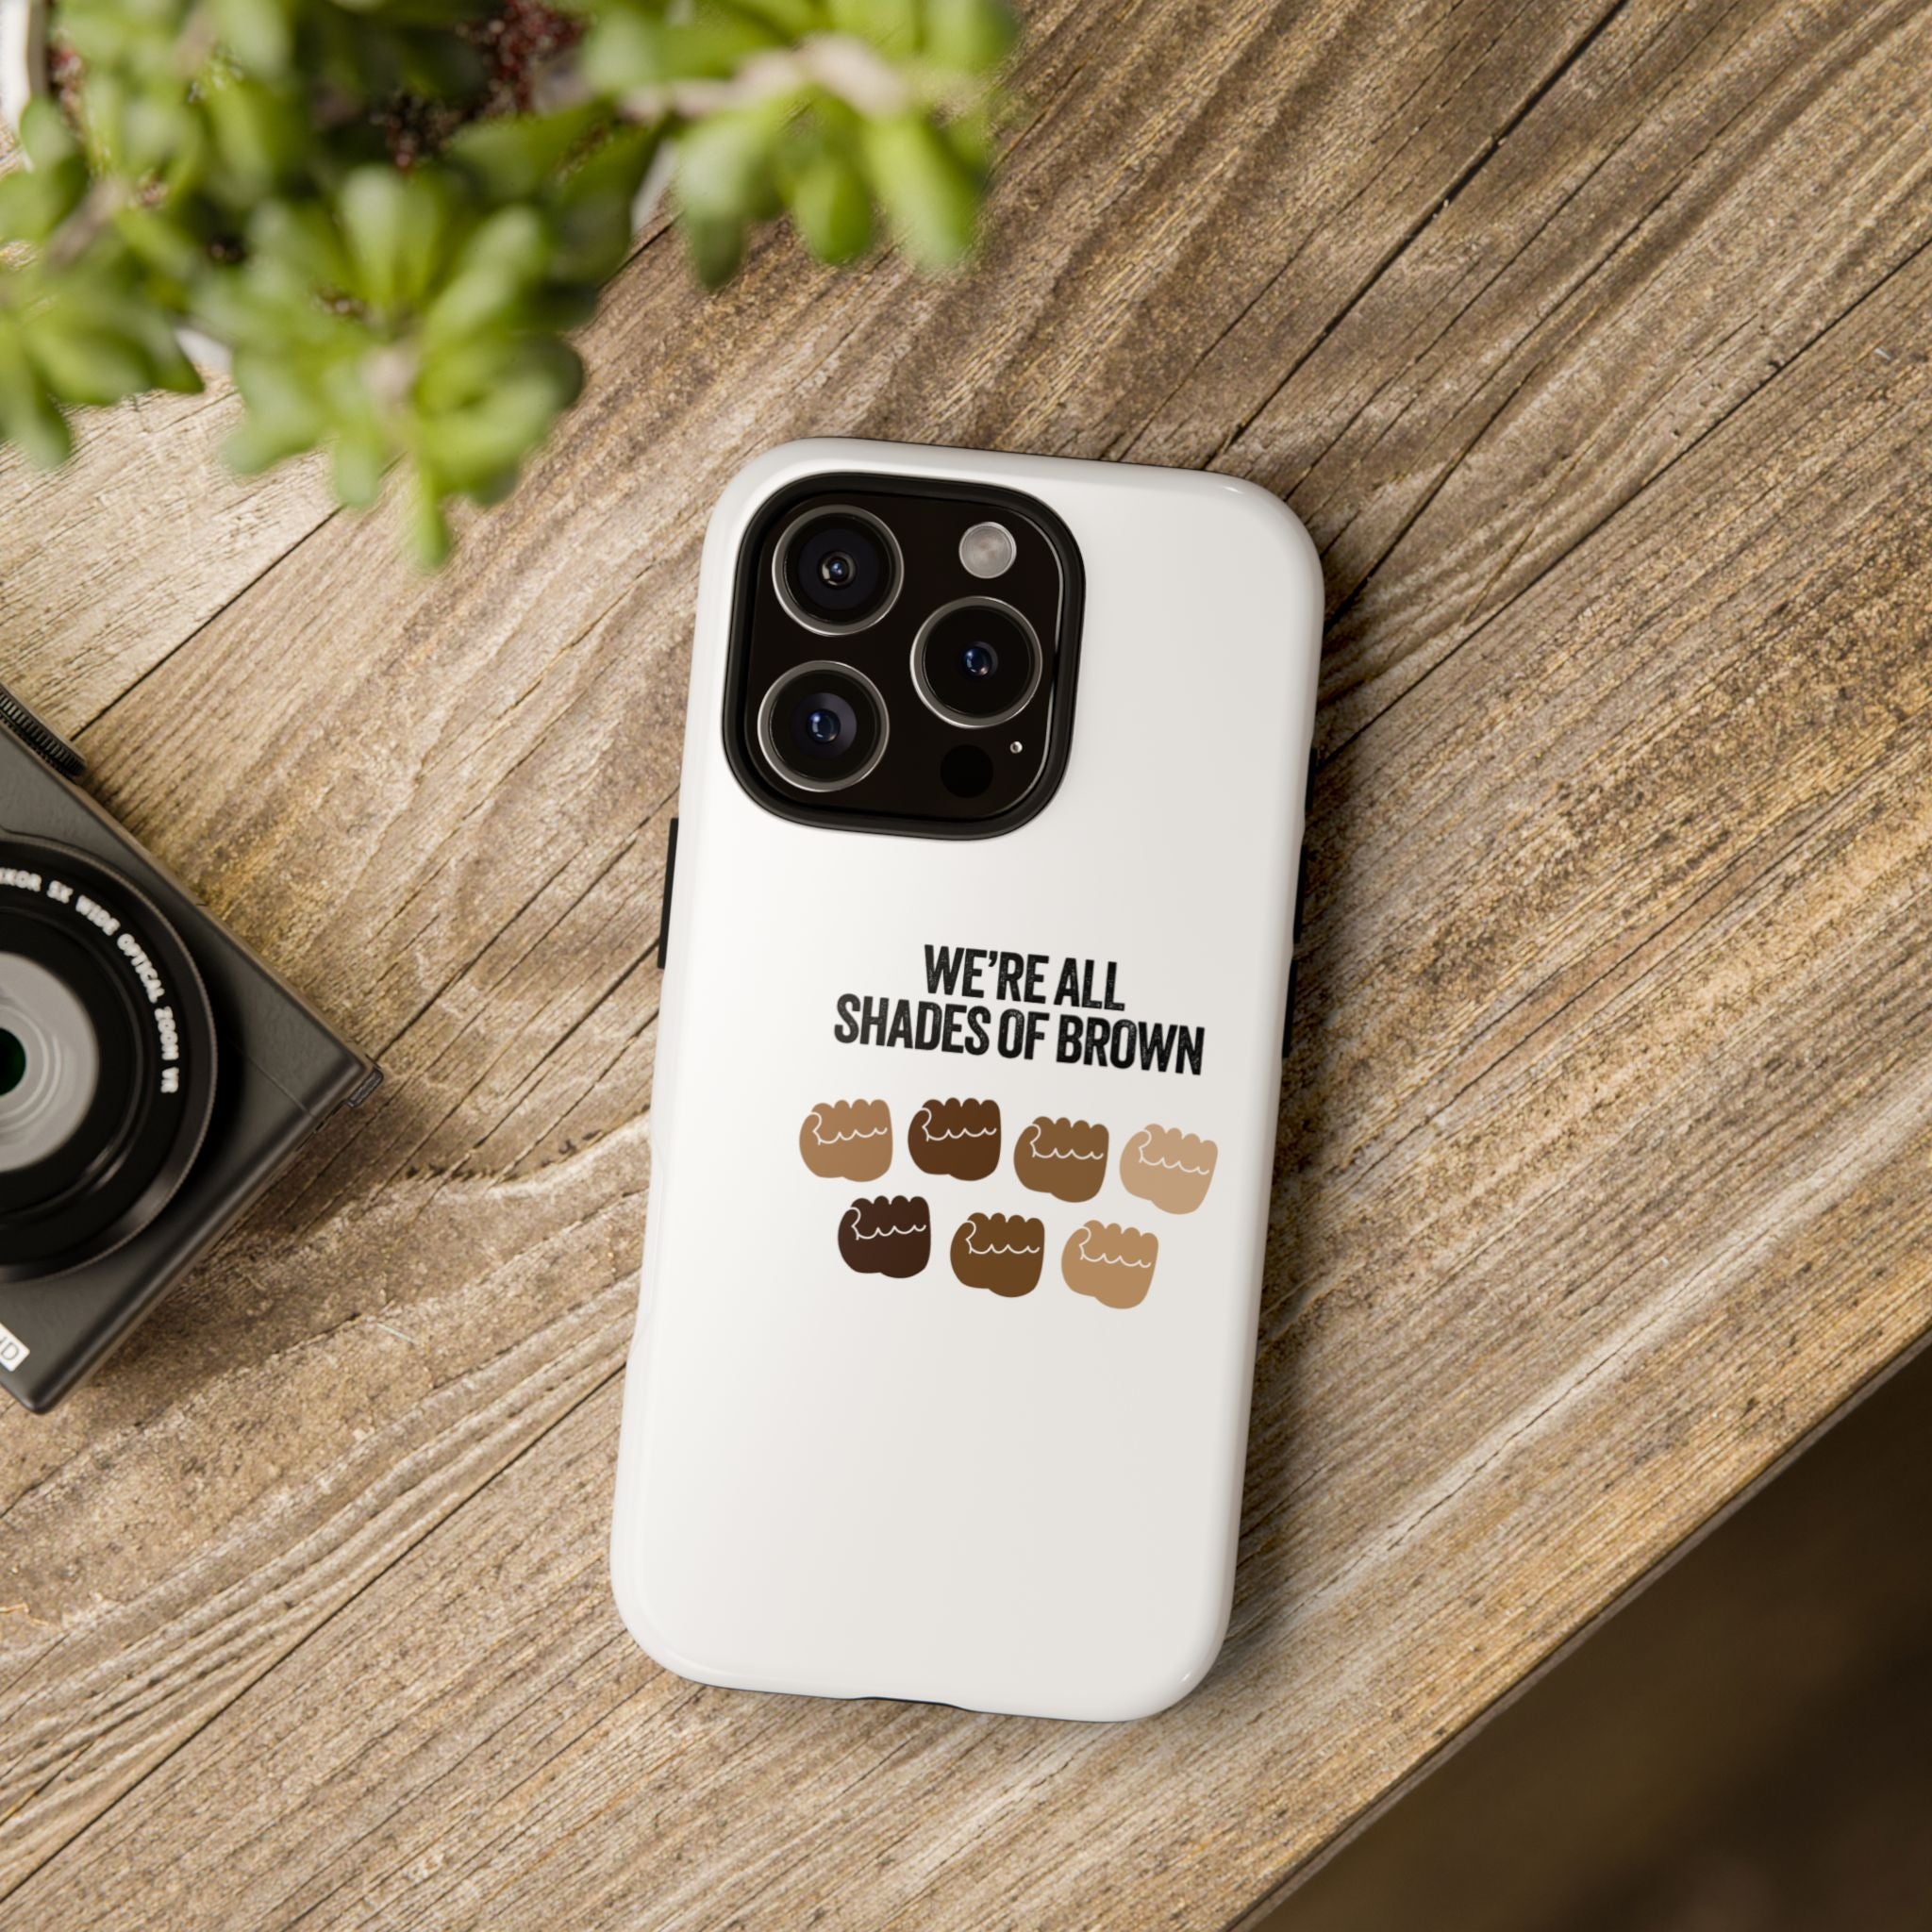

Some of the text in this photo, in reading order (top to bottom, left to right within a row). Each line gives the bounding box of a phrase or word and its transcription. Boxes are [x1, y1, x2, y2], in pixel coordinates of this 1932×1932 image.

[75, 895, 121, 936] WIDE
[117, 933, 165, 1004] OPTICAL
[924, 943, 1125, 1012] WE’RE ALL
[155, 1006, 179, 1060] ZOOM
[834, 993, 1206, 1076] SHADES OF BROWN
[160, 1067, 179, 1093] VR
